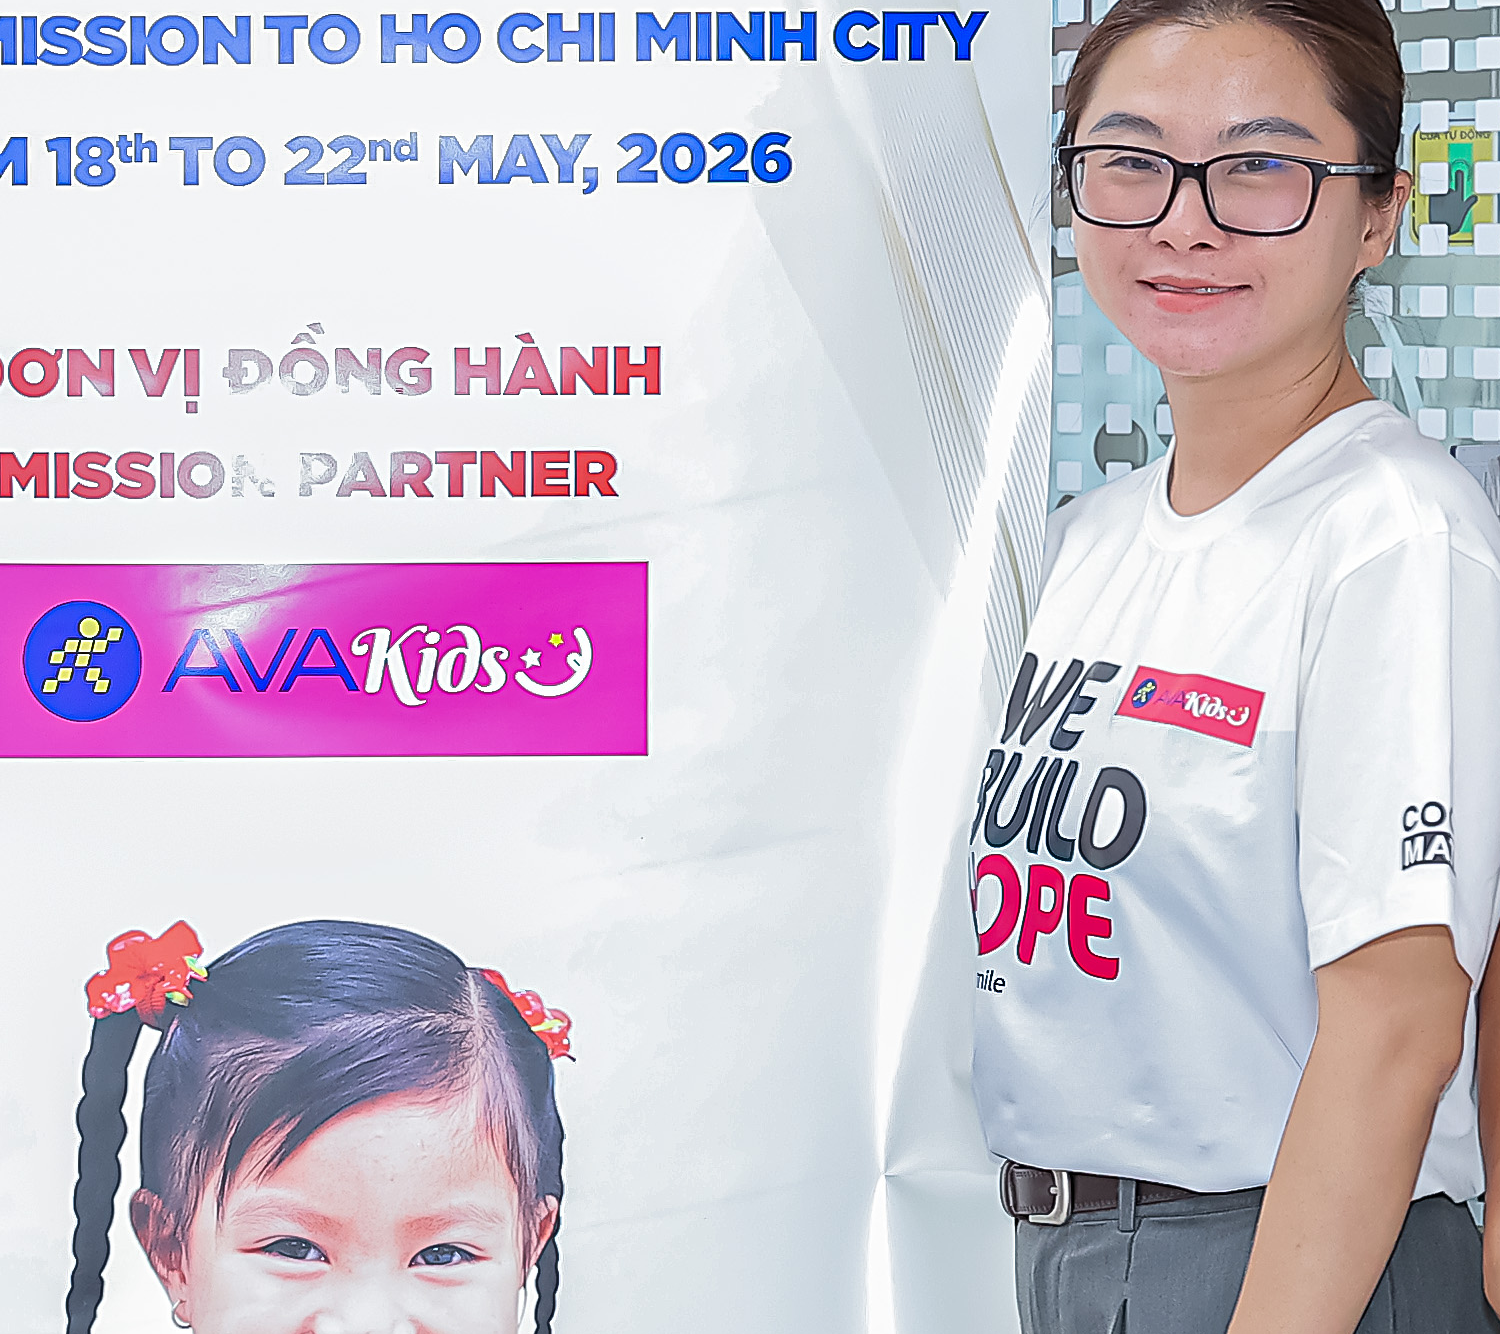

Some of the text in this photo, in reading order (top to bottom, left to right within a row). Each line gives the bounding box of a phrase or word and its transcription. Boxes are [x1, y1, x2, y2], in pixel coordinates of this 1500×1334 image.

[264, 14, 361, 64] TO
[380, 13, 481, 64] HO
[497, 12, 615, 63] CHI
[636, 11, 817, 61] MINH
[833, 10, 989, 62] CITY
[45, 133, 157, 187] 18th
[169, 136, 266, 187] TO
[284, 132, 418, 185] 22nd
[438, 134, 598, 195] MAY,
[617, 132, 792, 184] 2026
[128, 346, 200, 414] VỊ
[221, 322, 432, 398] ĐỒNG
[453, 333, 662, 397] HÀNH
[298, 450, 619, 499] PARTNER
[1000, 652, 1122, 751] WE
[970, 853, 1120, 980] OPE
